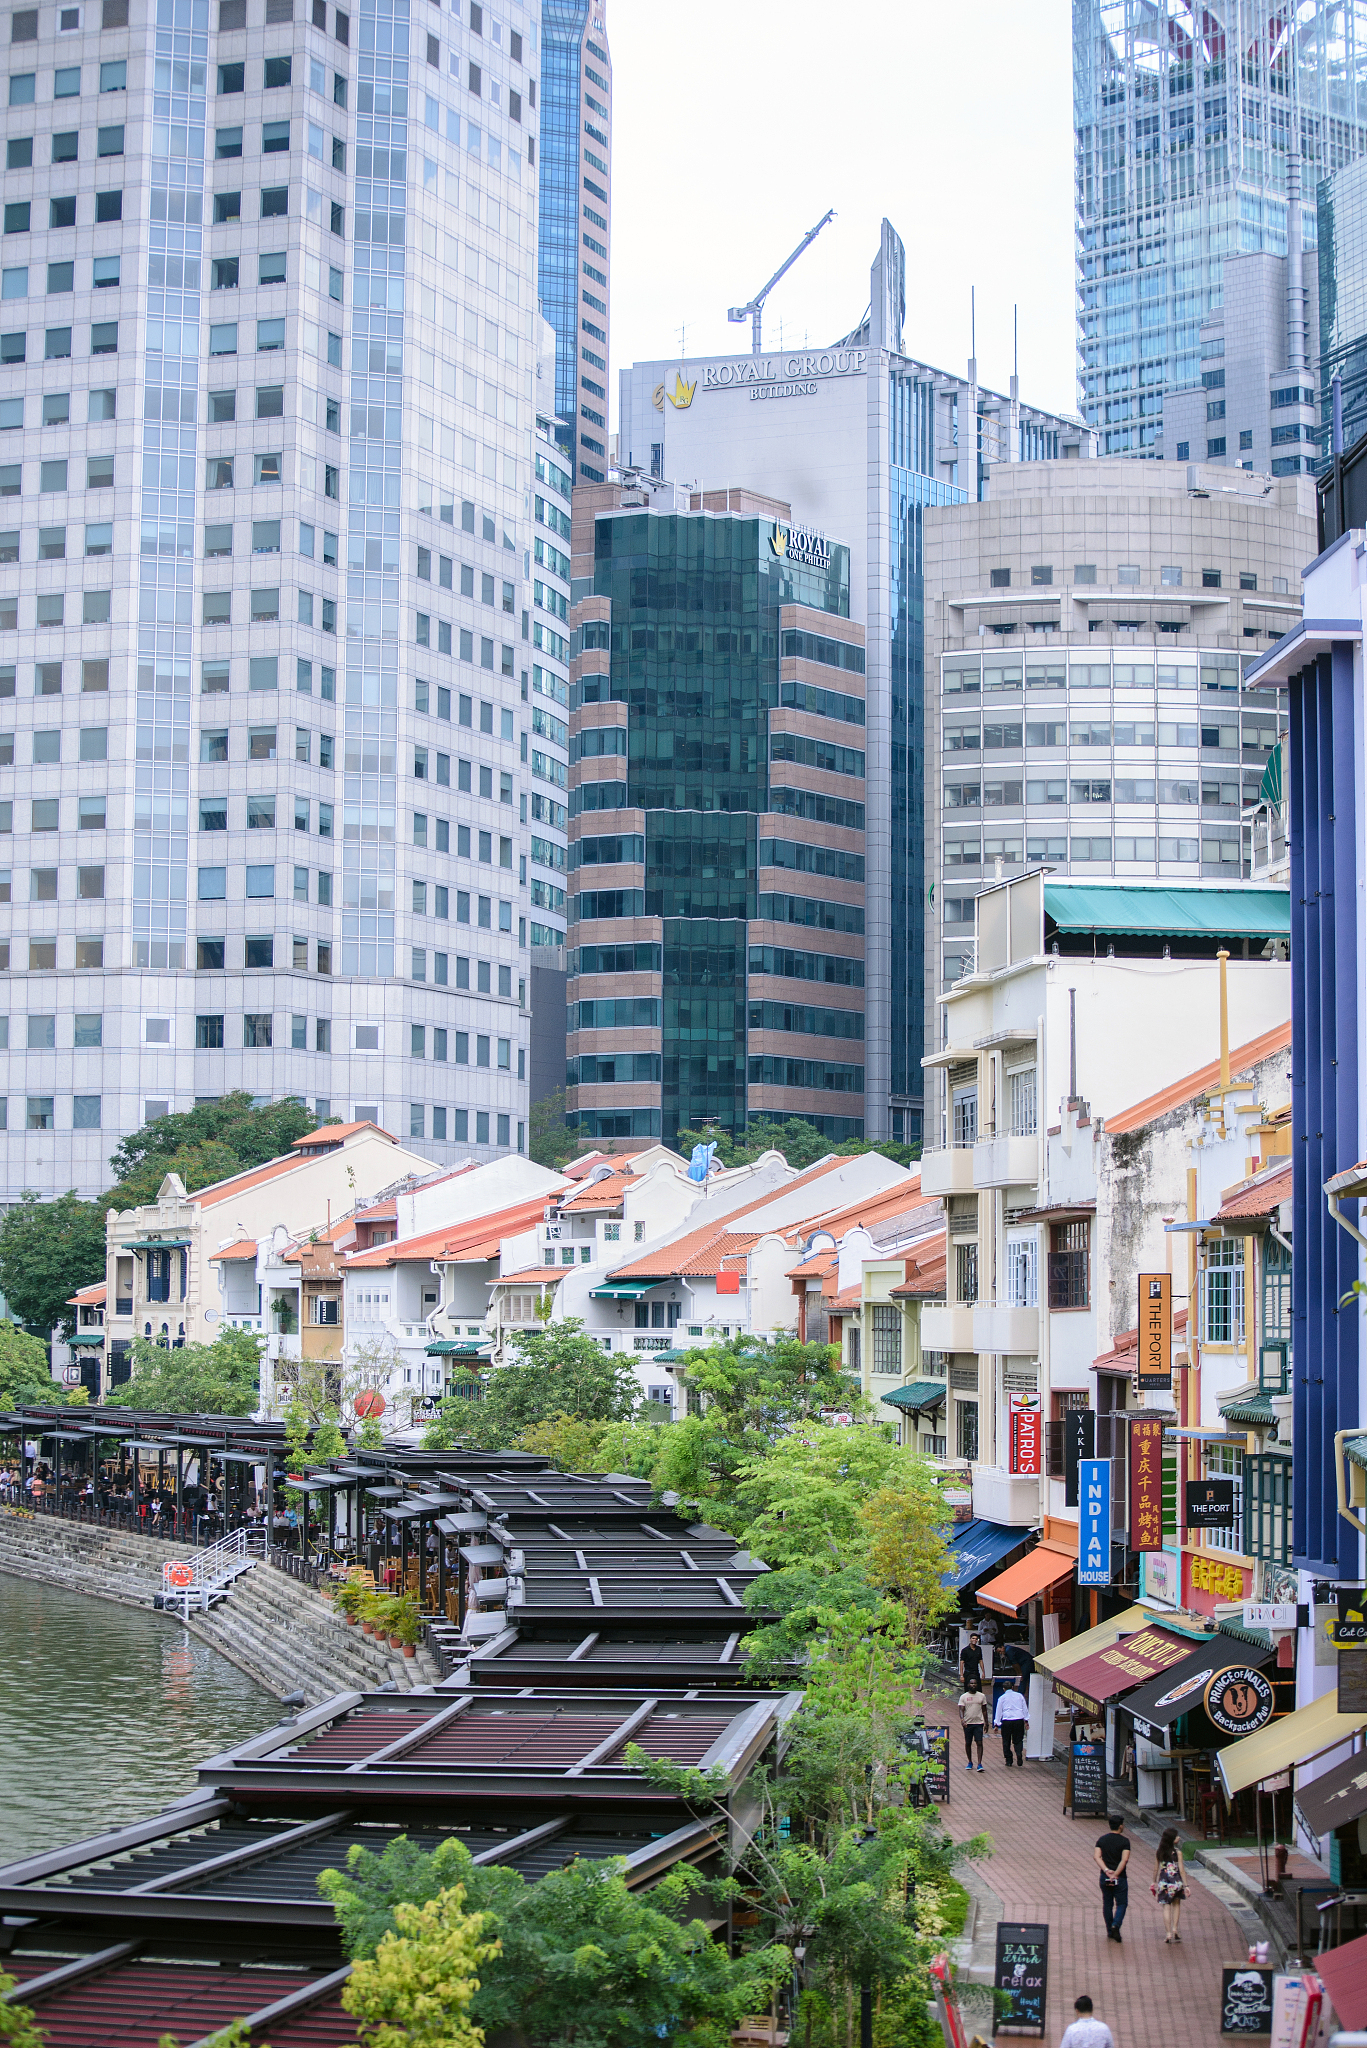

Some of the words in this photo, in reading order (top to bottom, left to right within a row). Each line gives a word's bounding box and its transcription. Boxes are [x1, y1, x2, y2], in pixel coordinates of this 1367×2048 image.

[702, 361, 776, 387] ROYAL
[784, 351, 867, 378] GROUP
[750, 382, 818, 401] BUILDING
[787, 528, 831, 560] ROYAL
[788, 549, 804, 562] ONE
[804, 553, 831, 570] PHILLIP
[1149, 1302, 1161, 1330] THE
[1149, 1333, 1161, 1370] PORT
[1020, 1414, 1035, 1473] PATRO'S
[1088, 1467, 1102, 1568] INDIAN
[1191, 1504, 1208, 1513] THE
[1208, 1504, 1231, 1512] PORT
[1080, 1571, 1109, 1582] HOUSE
[1339, 1626, 1356, 1637] Cat
[1210, 1671, 1236, 1704] PRINCE
[1233, 1670, 1244, 1679] OF
[1243, 1669, 1270, 1698] WALES
[1213, 1710, 1260, 1732] Backpacker
[1002, 1953, 1042, 1964] drink
[1004, 1944, 1039, 1956] EAT
[1013, 1963, 1027, 1977] &
[1001, 1975, 1042, 1987] relax
